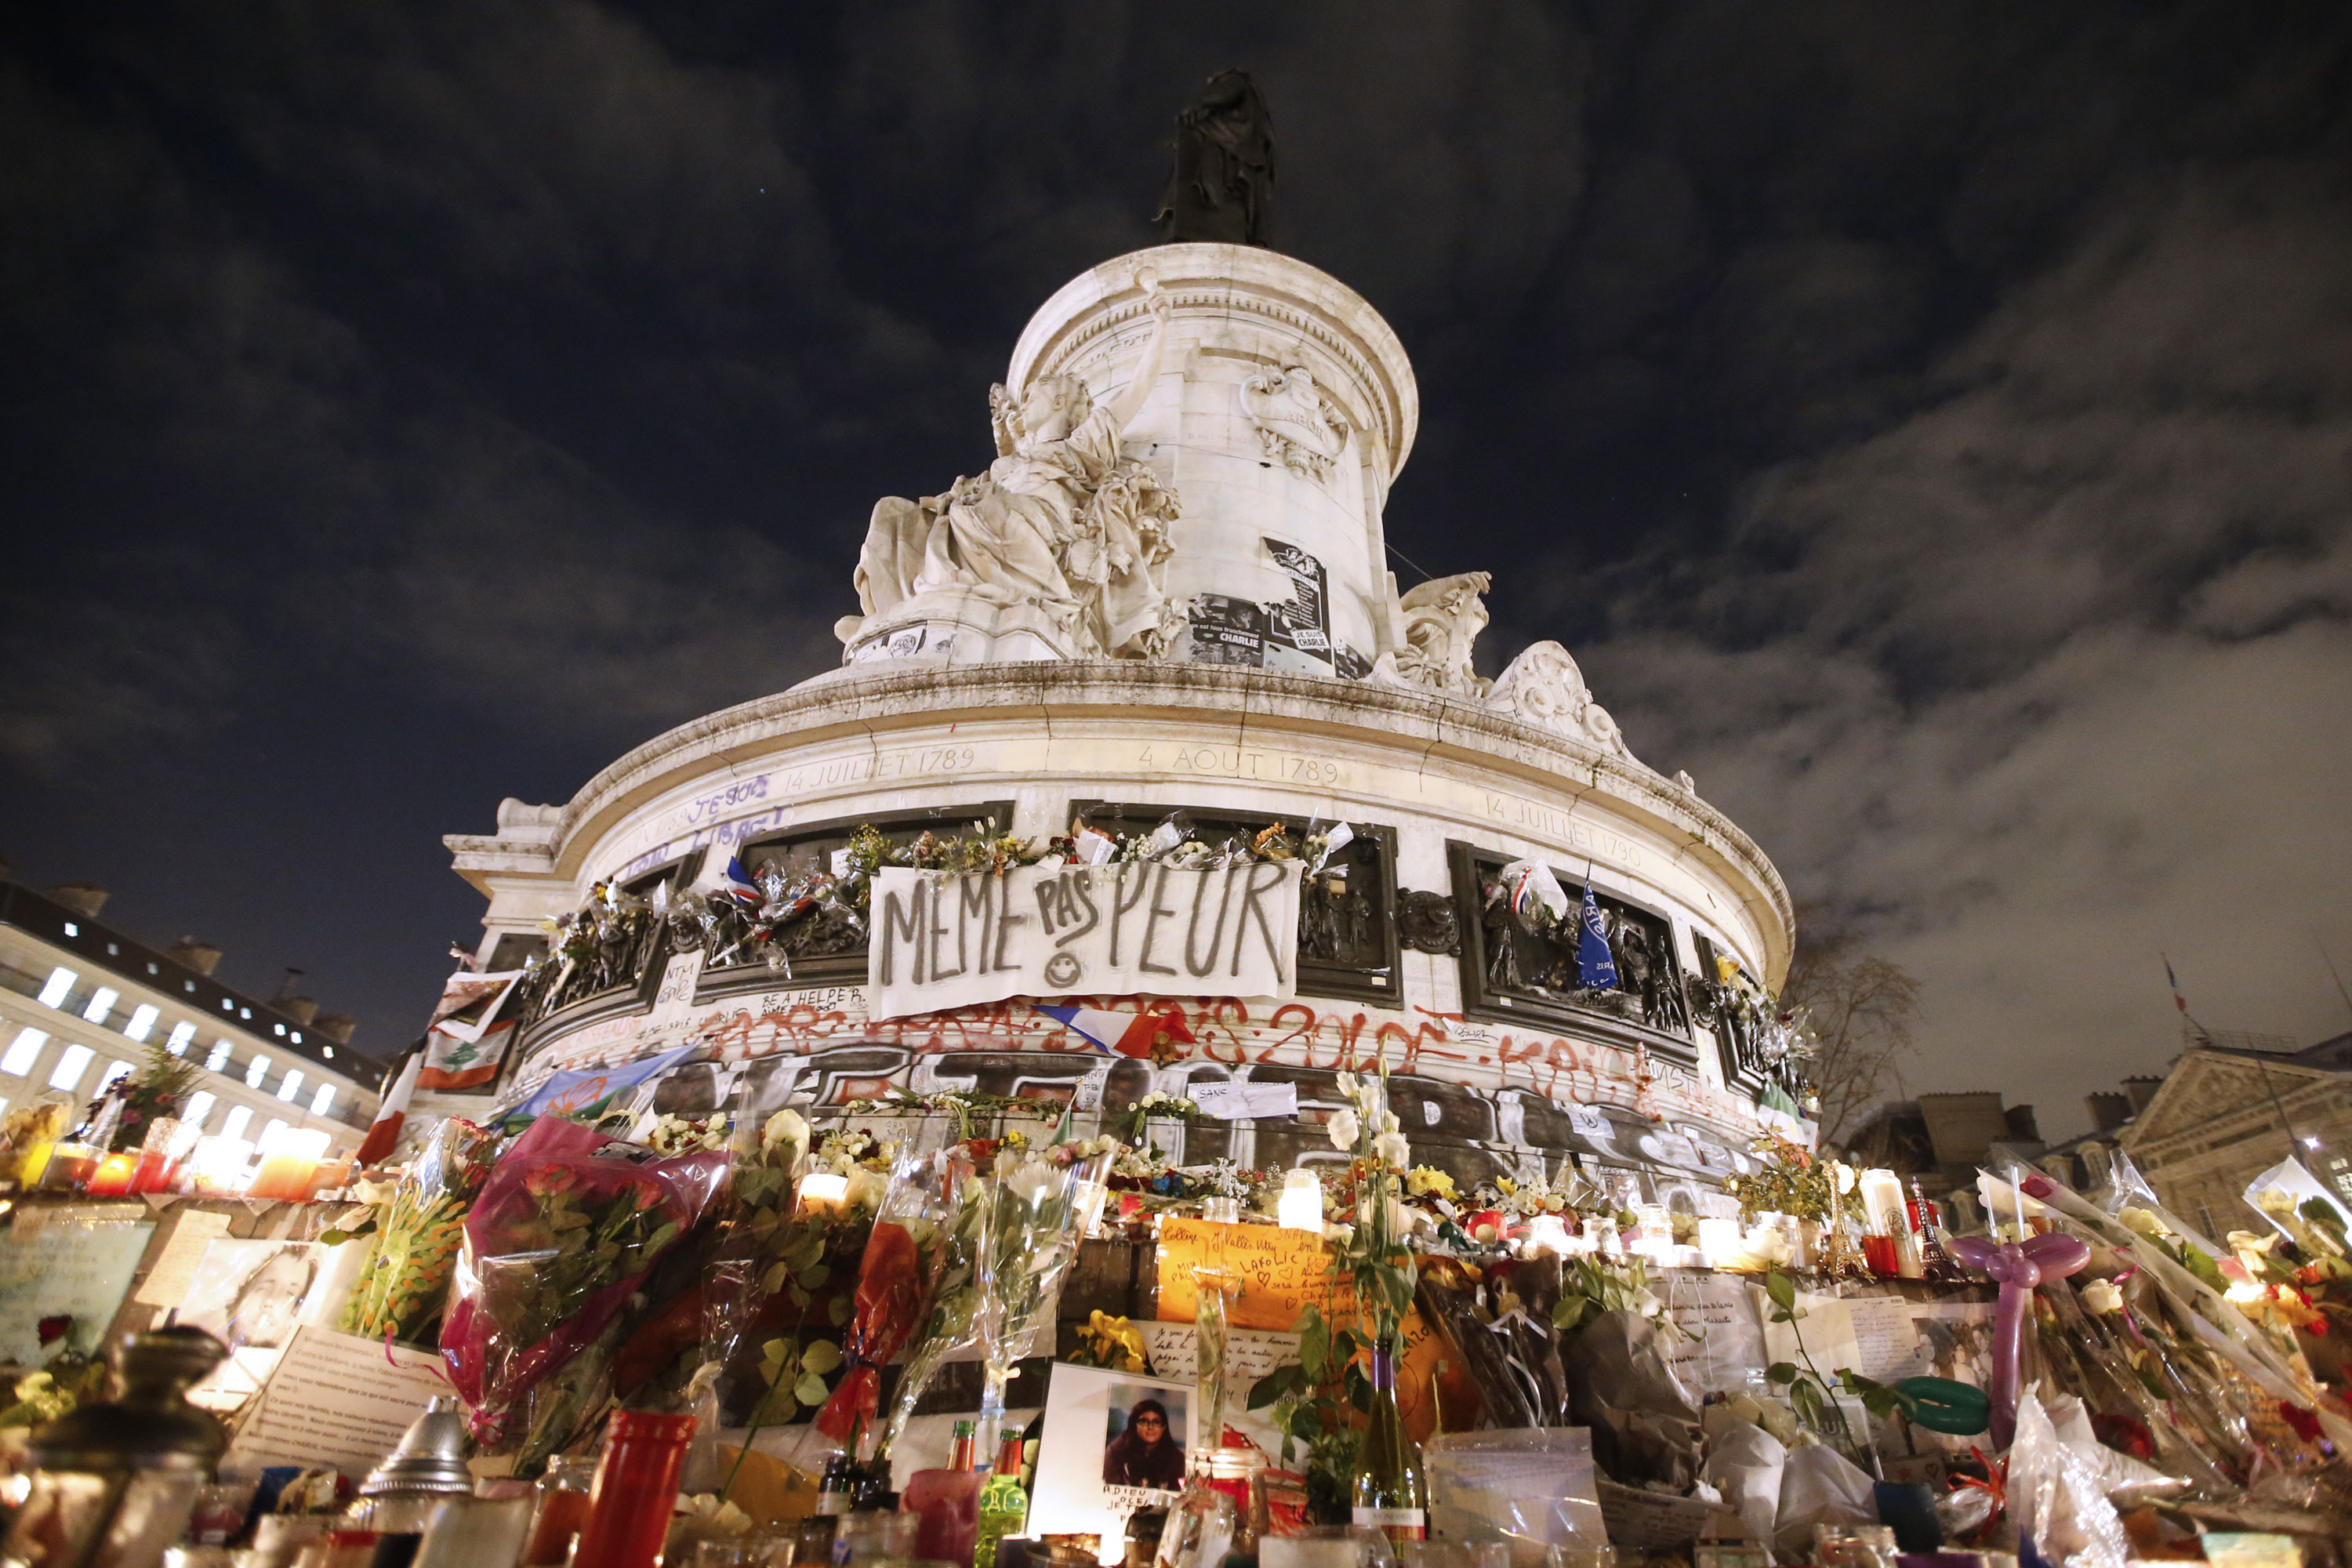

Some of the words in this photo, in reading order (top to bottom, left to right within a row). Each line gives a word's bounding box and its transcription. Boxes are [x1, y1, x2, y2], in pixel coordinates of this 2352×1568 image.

[1220, 633, 1259, 648] CHARLIE
[1298, 638, 1327, 647] CHARLIE
[785, 771, 803, 793] 14
[811, 753, 911, 787] JUILLET
[918, 749, 975, 773] 1789
[1138, 746, 1153, 767] 4
[1173, 747, 1264, 775] AOUT
[1280, 757, 1338, 784] 1789
[1486, 794, 1504, 818] 14
[1515, 804, 1595, 848] JUILLET
[1602, 833, 1642, 867] 1790
[1036, 869, 1101, 948] PAS
[1110, 862, 1287, 984] PEUR
[666, 962, 694, 981] NTM
[762, 993, 779, 1008] BE
[782, 993, 790, 1004] A
[1163, 1226, 1198, 1245] Collège
[1267, 1337, 1296, 1347] hommes
[1103, 1485, 1146, 1497] ADIEU
[1107, 1501, 1120, 1511] JE
